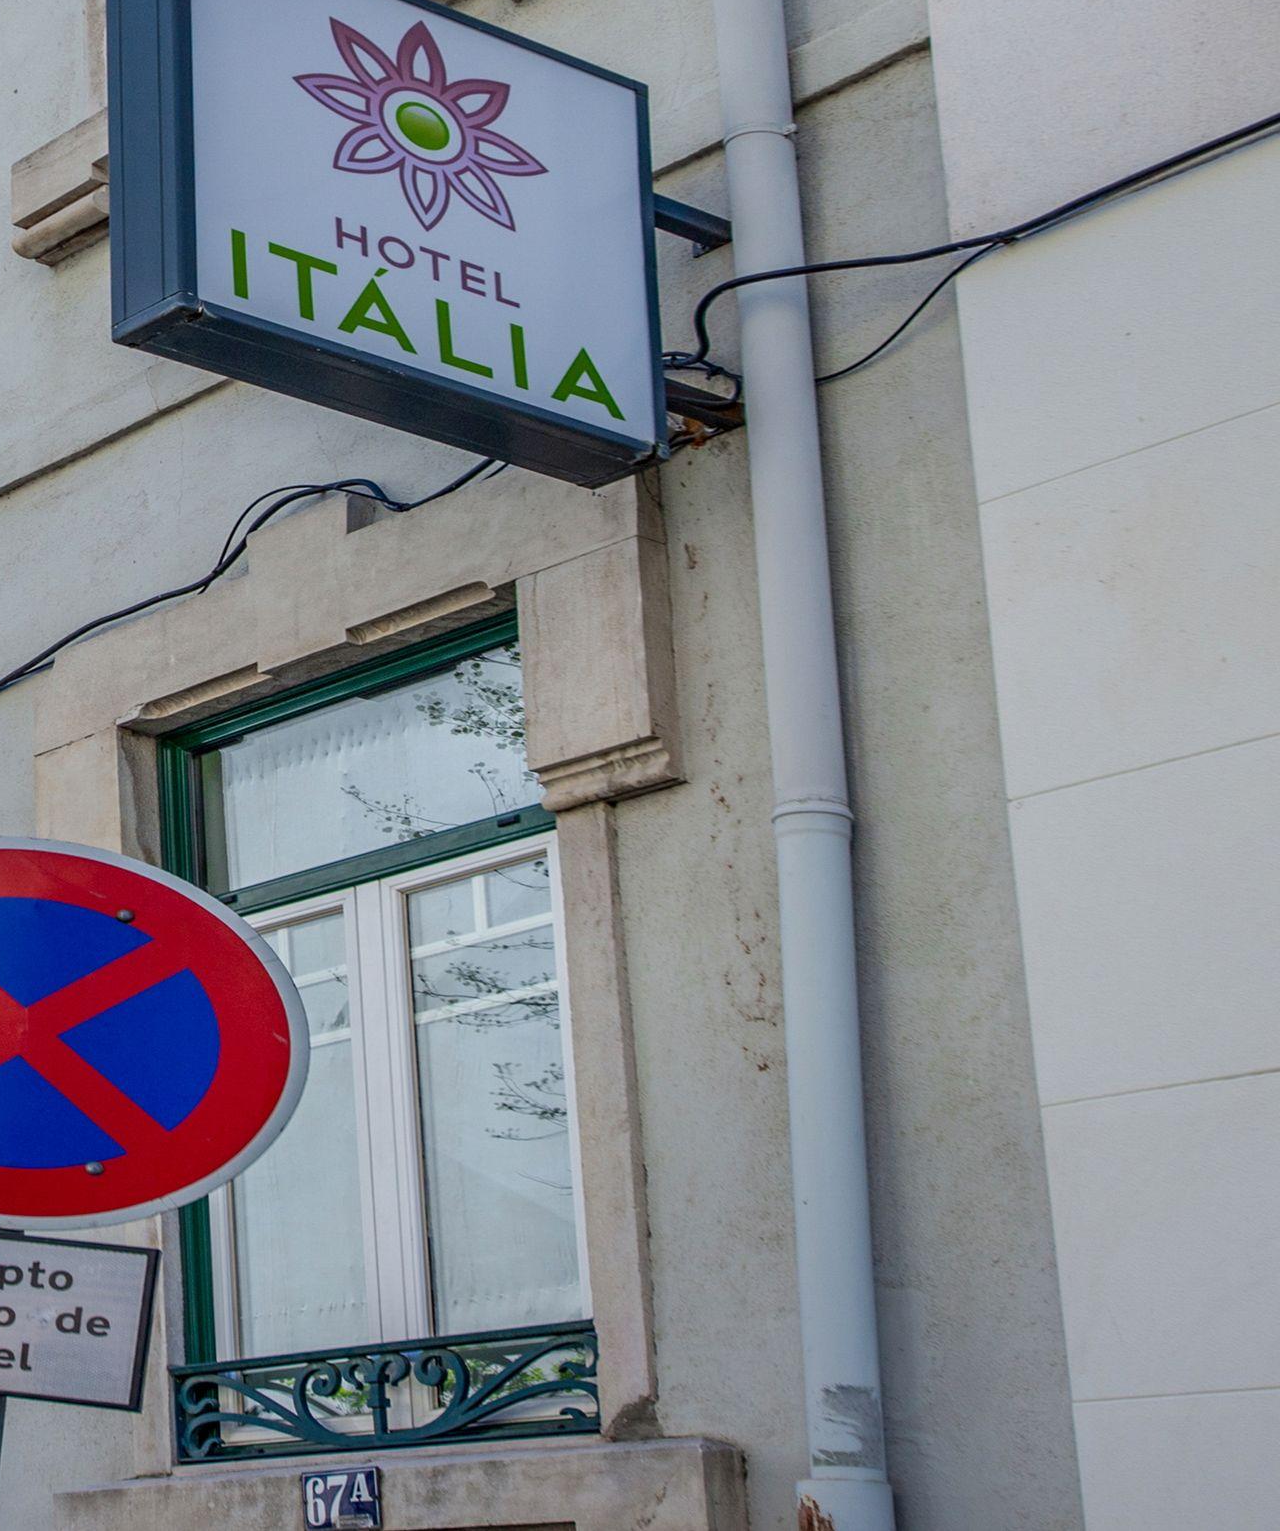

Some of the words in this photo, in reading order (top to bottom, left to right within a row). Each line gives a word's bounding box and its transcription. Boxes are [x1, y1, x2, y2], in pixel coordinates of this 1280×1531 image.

[335, 216, 521, 308] HOTEL
[230, 227, 627, 421] ITÁLIA
[54, 1306, 111, 1338] de
